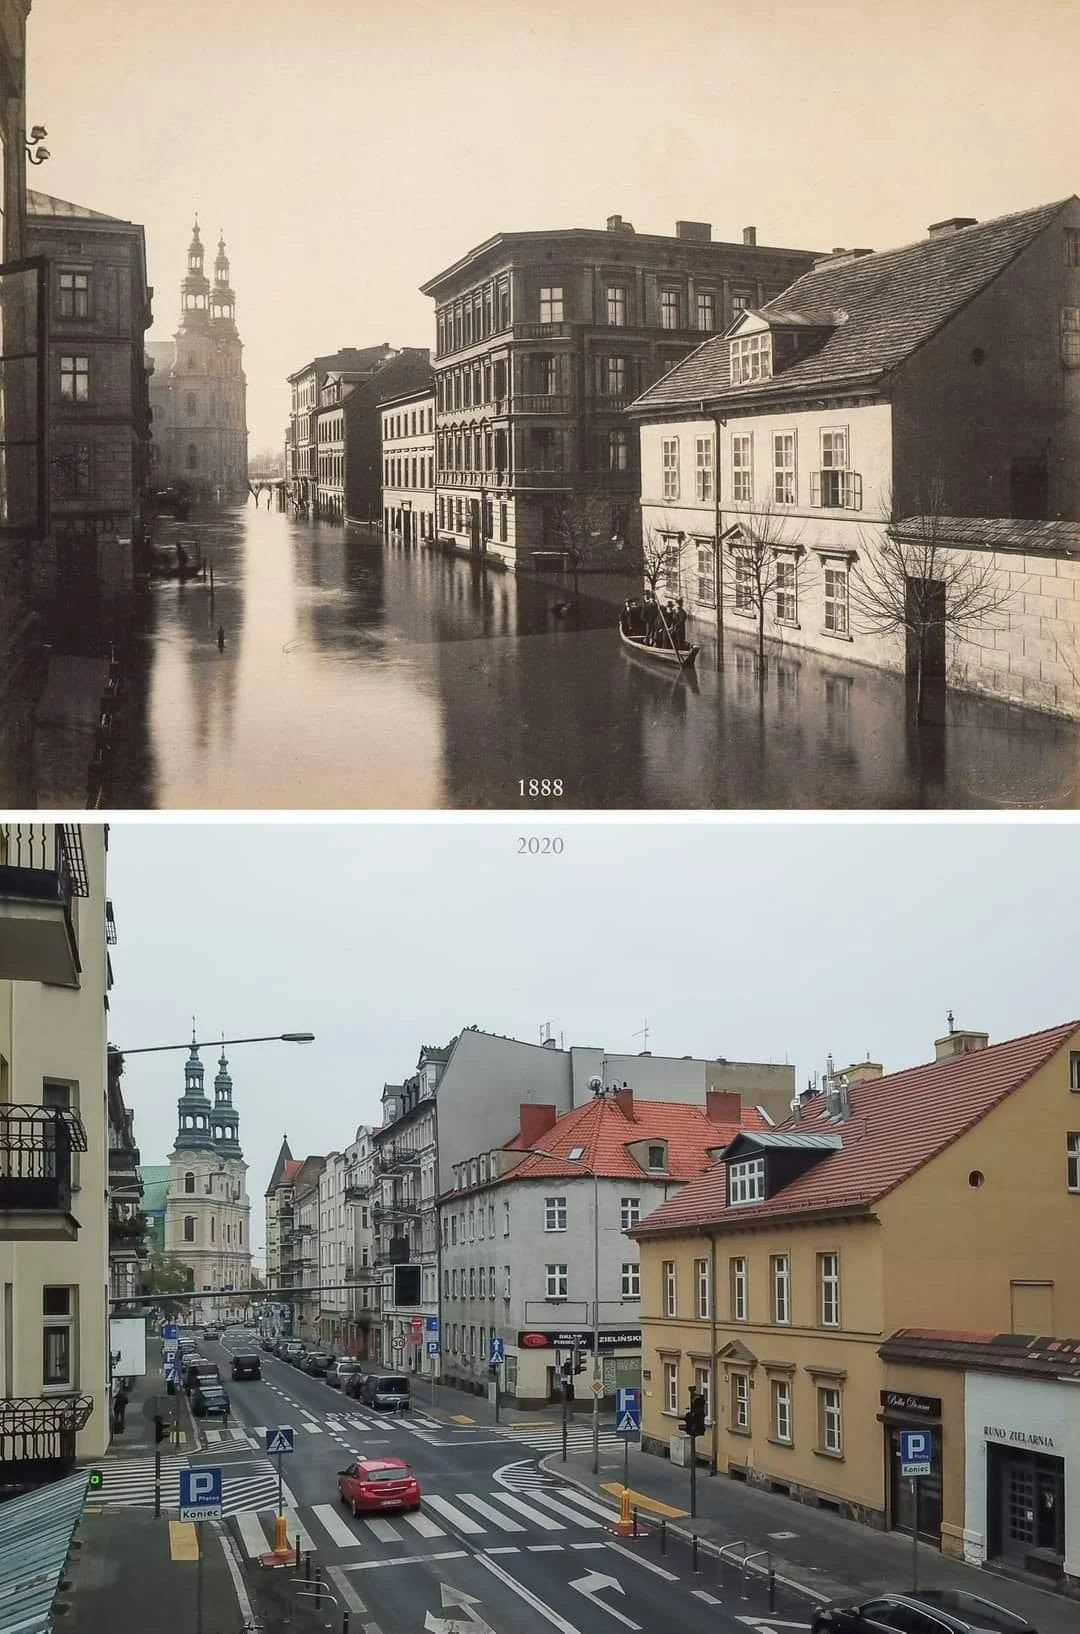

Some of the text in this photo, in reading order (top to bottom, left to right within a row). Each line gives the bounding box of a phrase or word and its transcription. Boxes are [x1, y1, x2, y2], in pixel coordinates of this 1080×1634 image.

[428, 1343, 437, 1353] P
[167, 1352, 176, 1362] P
[984, 1425, 1006, 1438] RUNO
[908, 1435, 925, 1459] P
[903, 1465, 929, 1473] Koniec
[190, 1473, 214, 1502] P
[183, 1510, 219, 1519] Koniec
